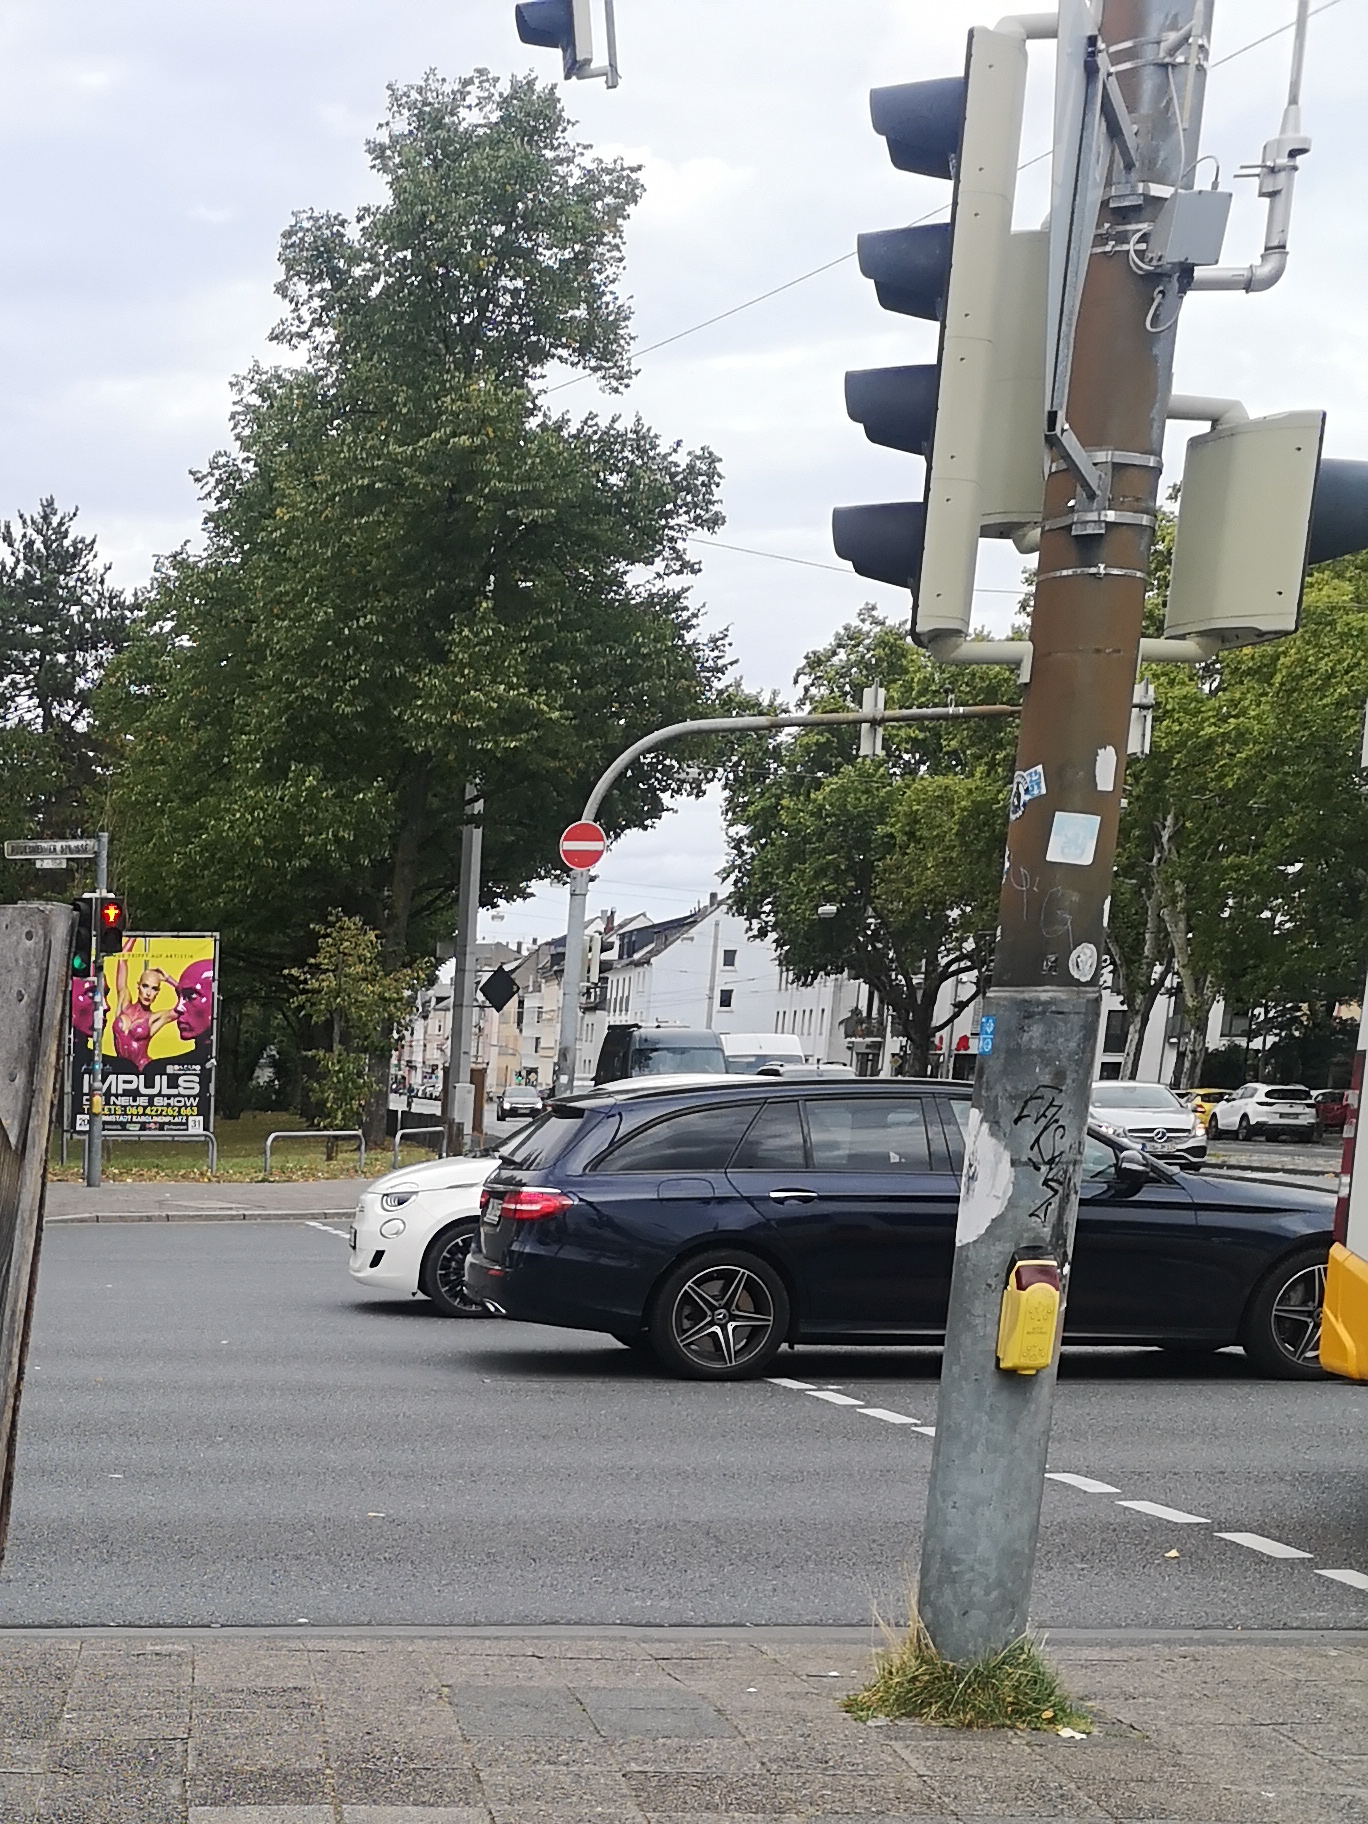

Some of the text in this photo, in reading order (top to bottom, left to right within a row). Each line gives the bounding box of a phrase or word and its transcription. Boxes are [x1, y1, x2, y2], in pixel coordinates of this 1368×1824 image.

[83, 1074, 200, 1095] IMPULS
[110, 1096, 149, 1106] NEUE
[154, 1097, 199, 1107] SHOW
[126, 1106, 143, 1114] 069
[145, 1107, 178, 1115] 427262
[180, 1107, 198, 1115] 663
